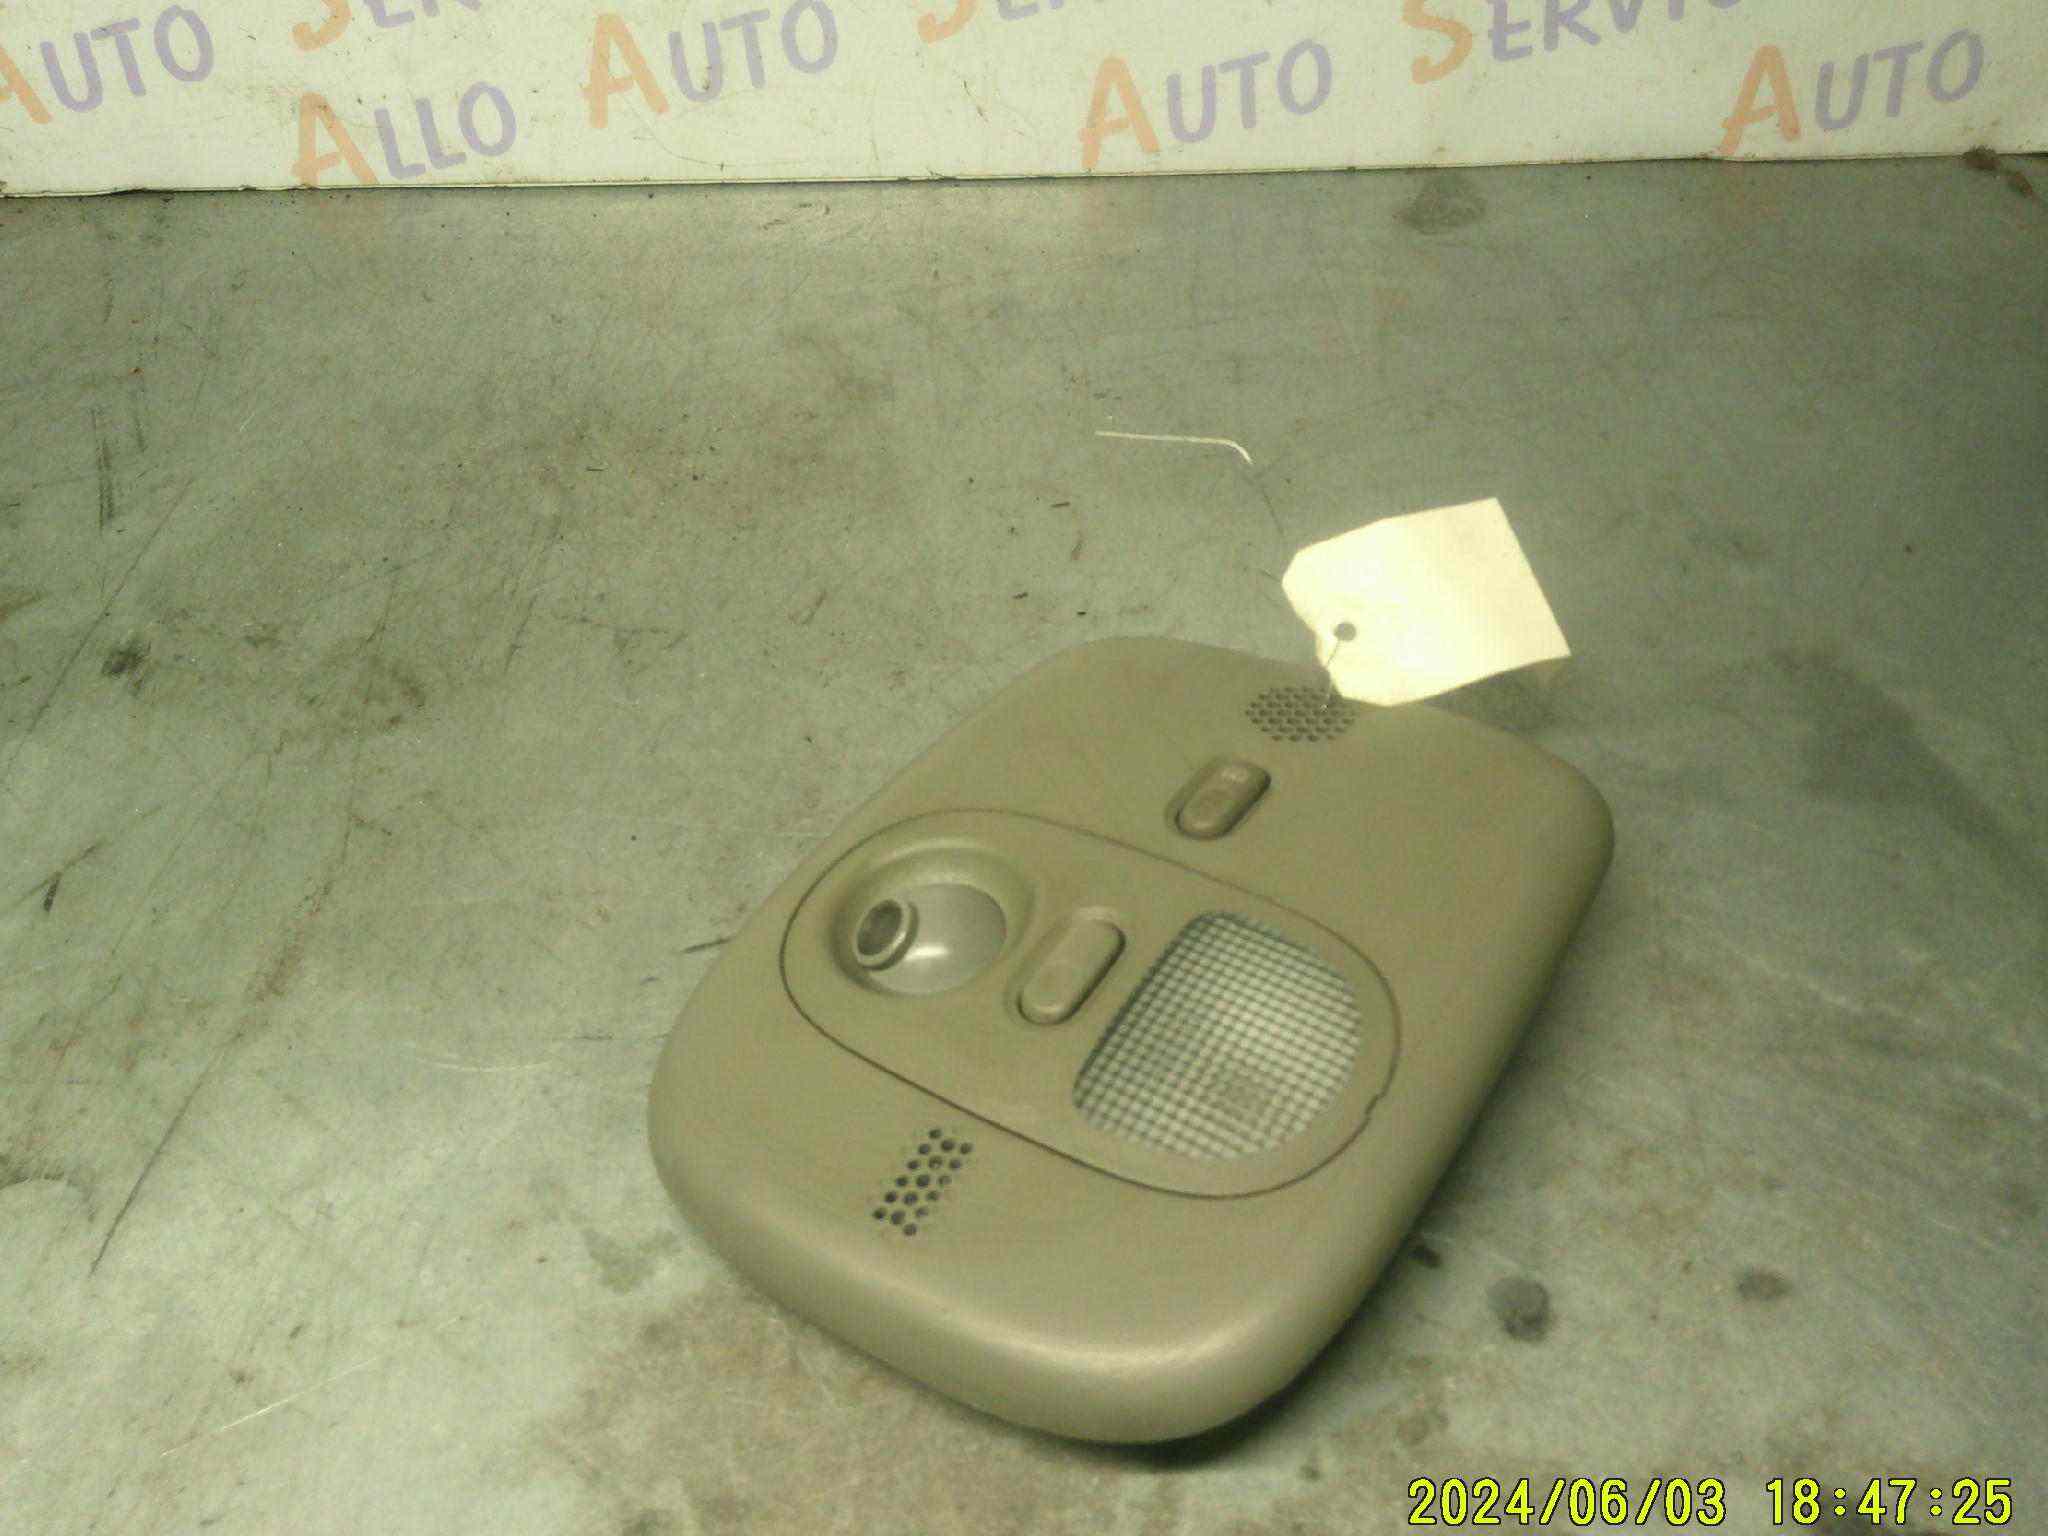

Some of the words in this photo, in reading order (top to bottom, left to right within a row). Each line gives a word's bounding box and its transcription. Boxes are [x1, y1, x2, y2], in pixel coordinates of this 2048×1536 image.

[292, 81, 517, 185] ALLO
[580, 0, 839, 128] AUTO
[1080, 39, 1332, 168] AUTO
[1722, 29, 1986, 154] AUTO
